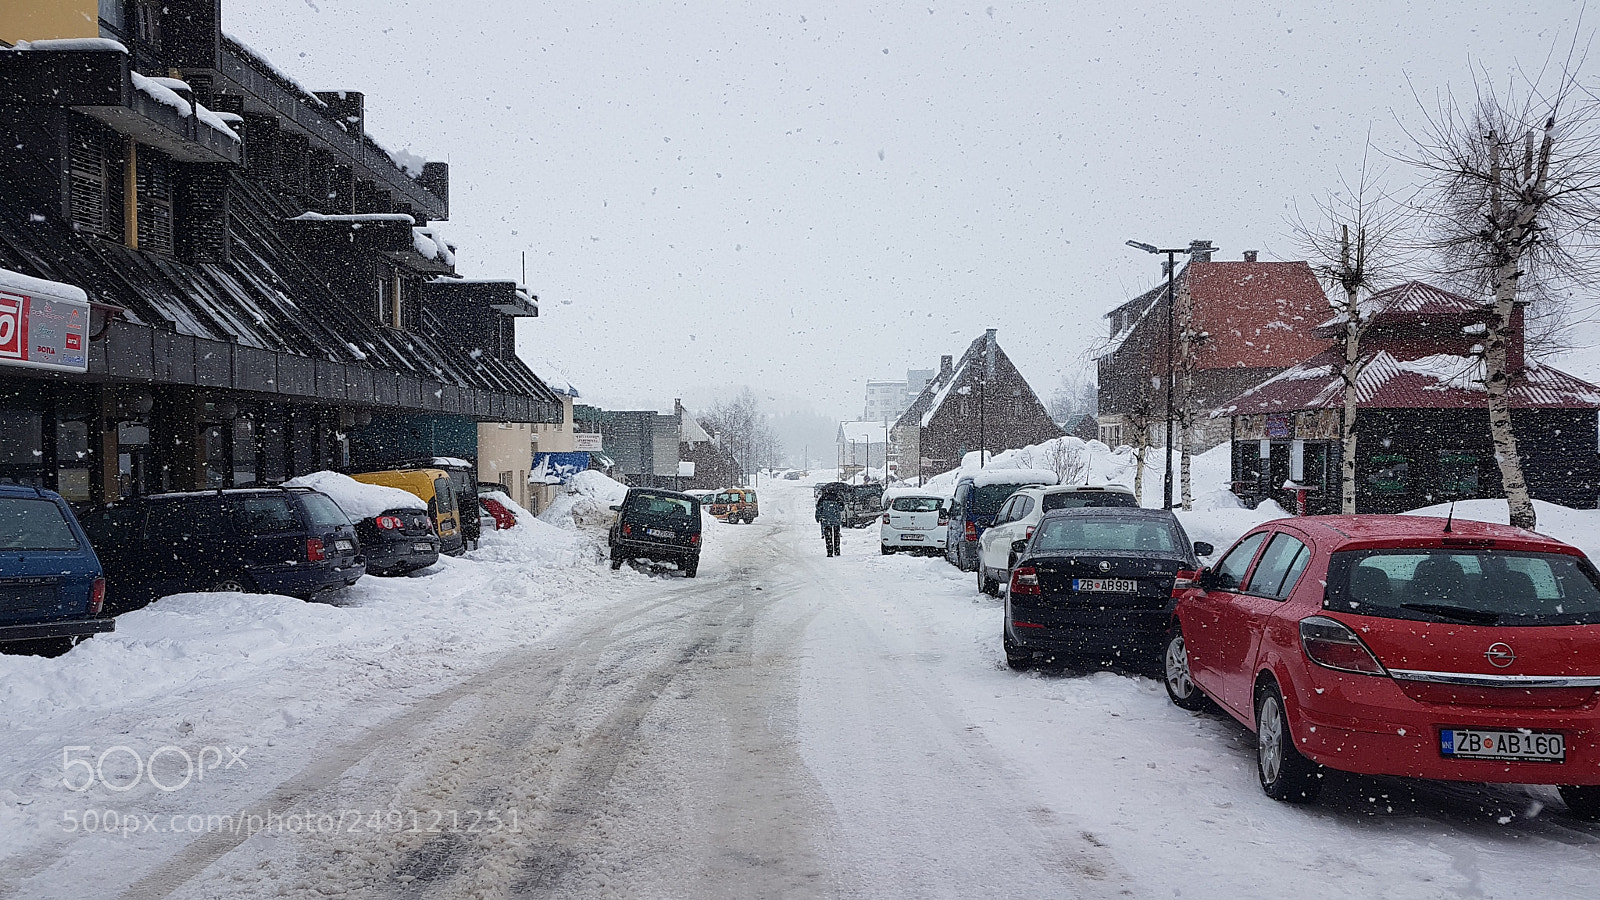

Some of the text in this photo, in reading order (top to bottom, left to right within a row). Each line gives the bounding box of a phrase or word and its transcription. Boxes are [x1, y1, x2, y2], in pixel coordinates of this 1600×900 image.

[1080, 580, 1094, 591] ZB
[1101, 580, 1136, 592] AB991
[1456, 732, 1561, 755] ZB AB160
